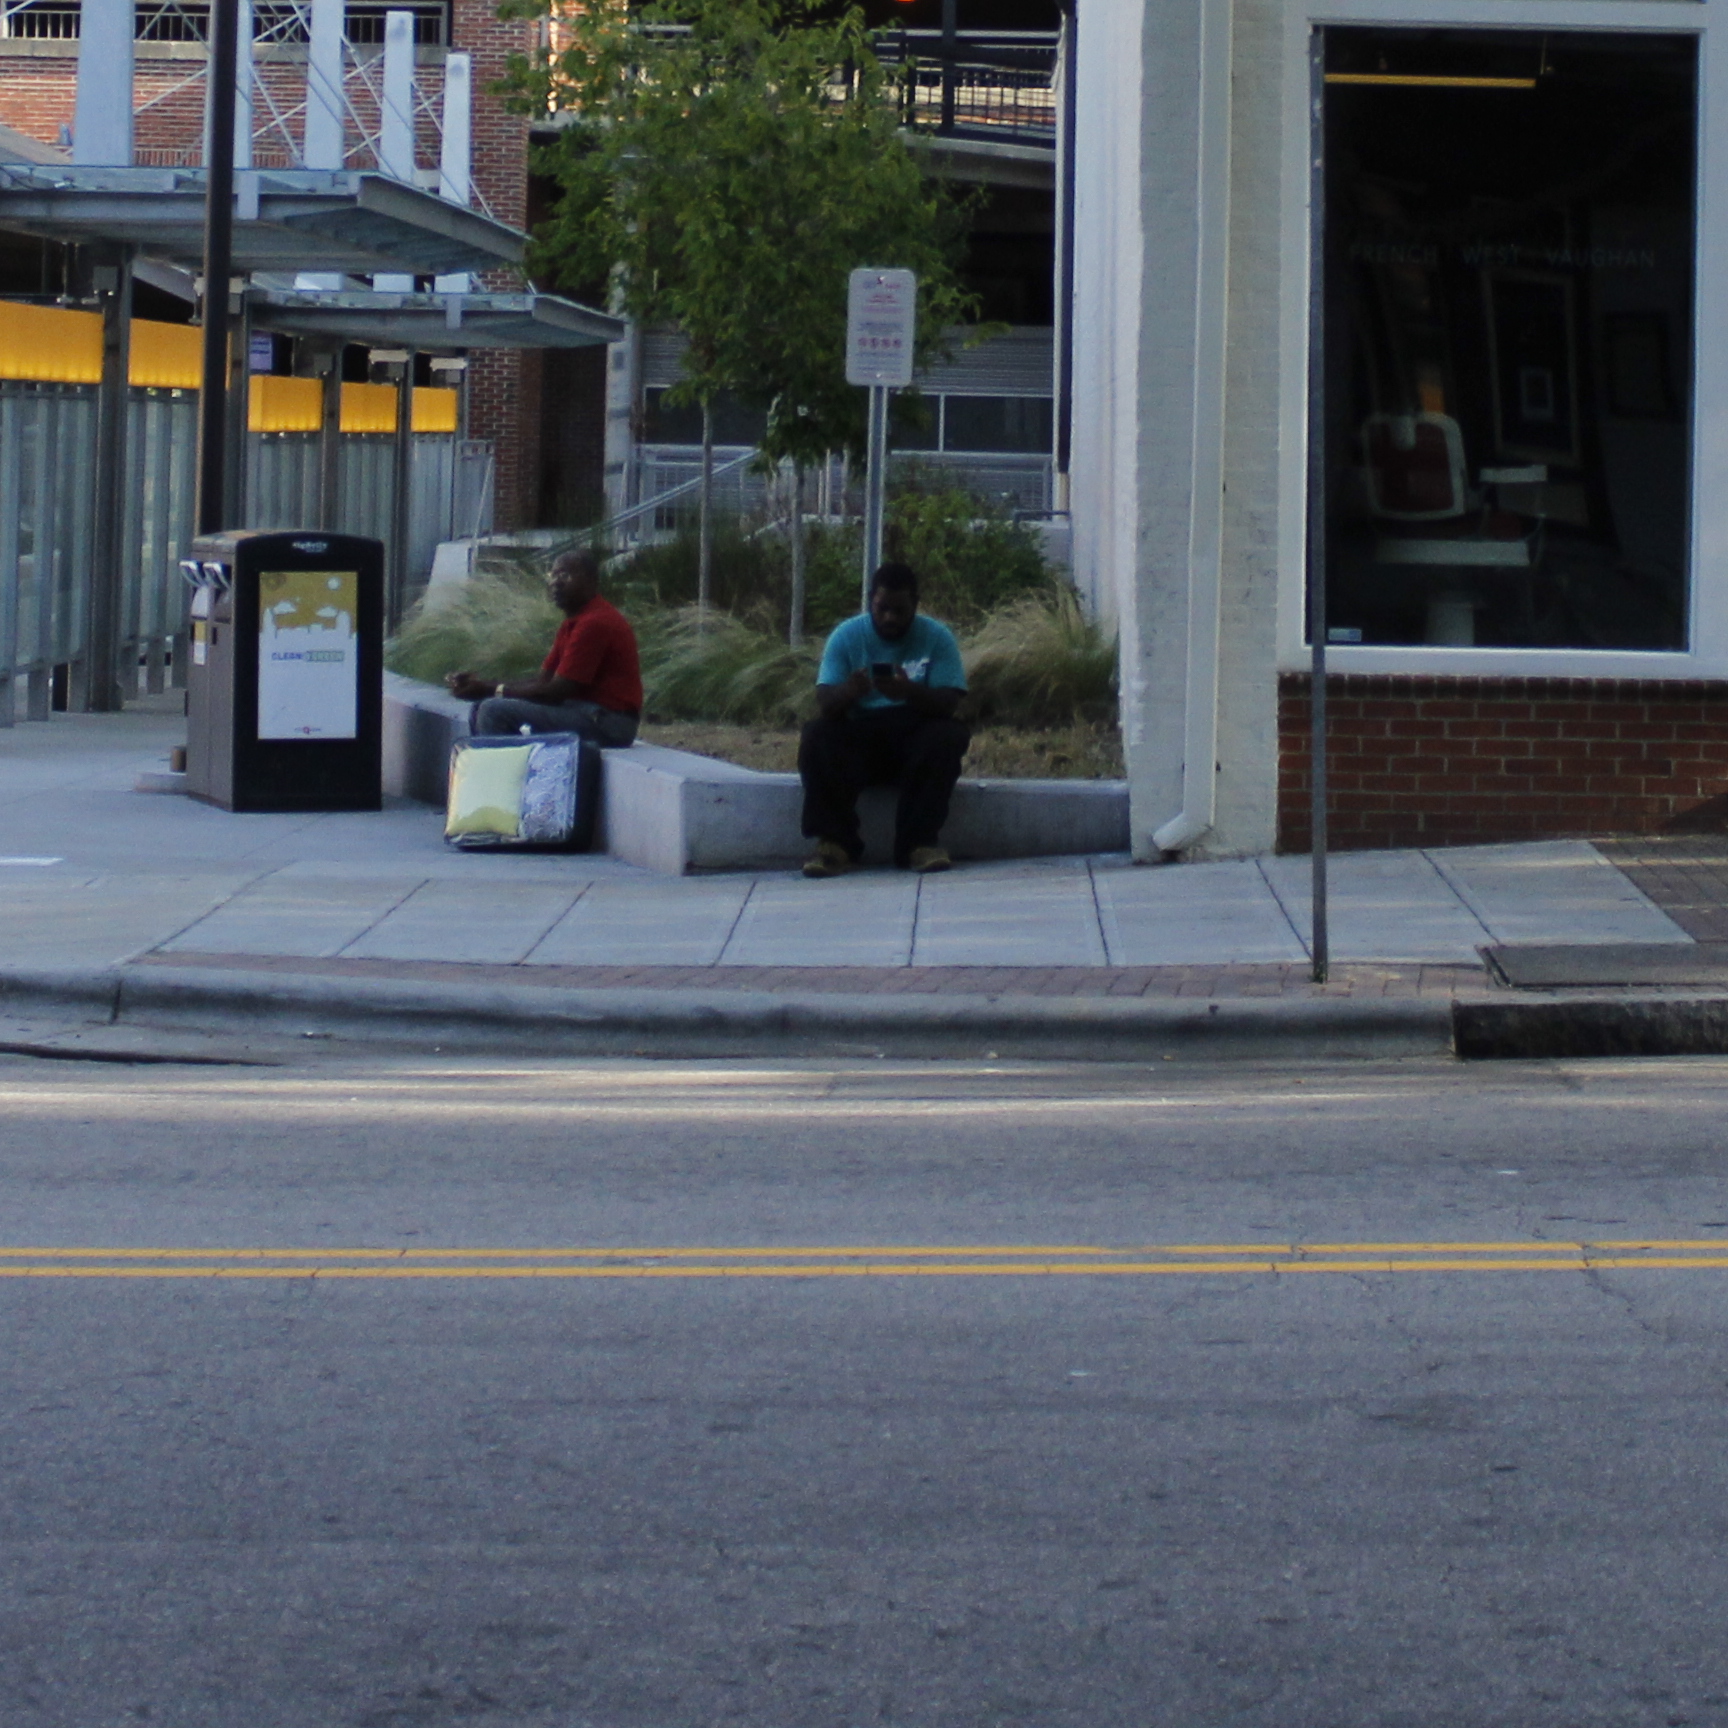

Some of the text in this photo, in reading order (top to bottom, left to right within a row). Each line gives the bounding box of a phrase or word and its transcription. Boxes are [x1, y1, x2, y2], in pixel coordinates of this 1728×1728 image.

[1349, 243, 1656, 268] FRENCH WEST VAUGHAN
